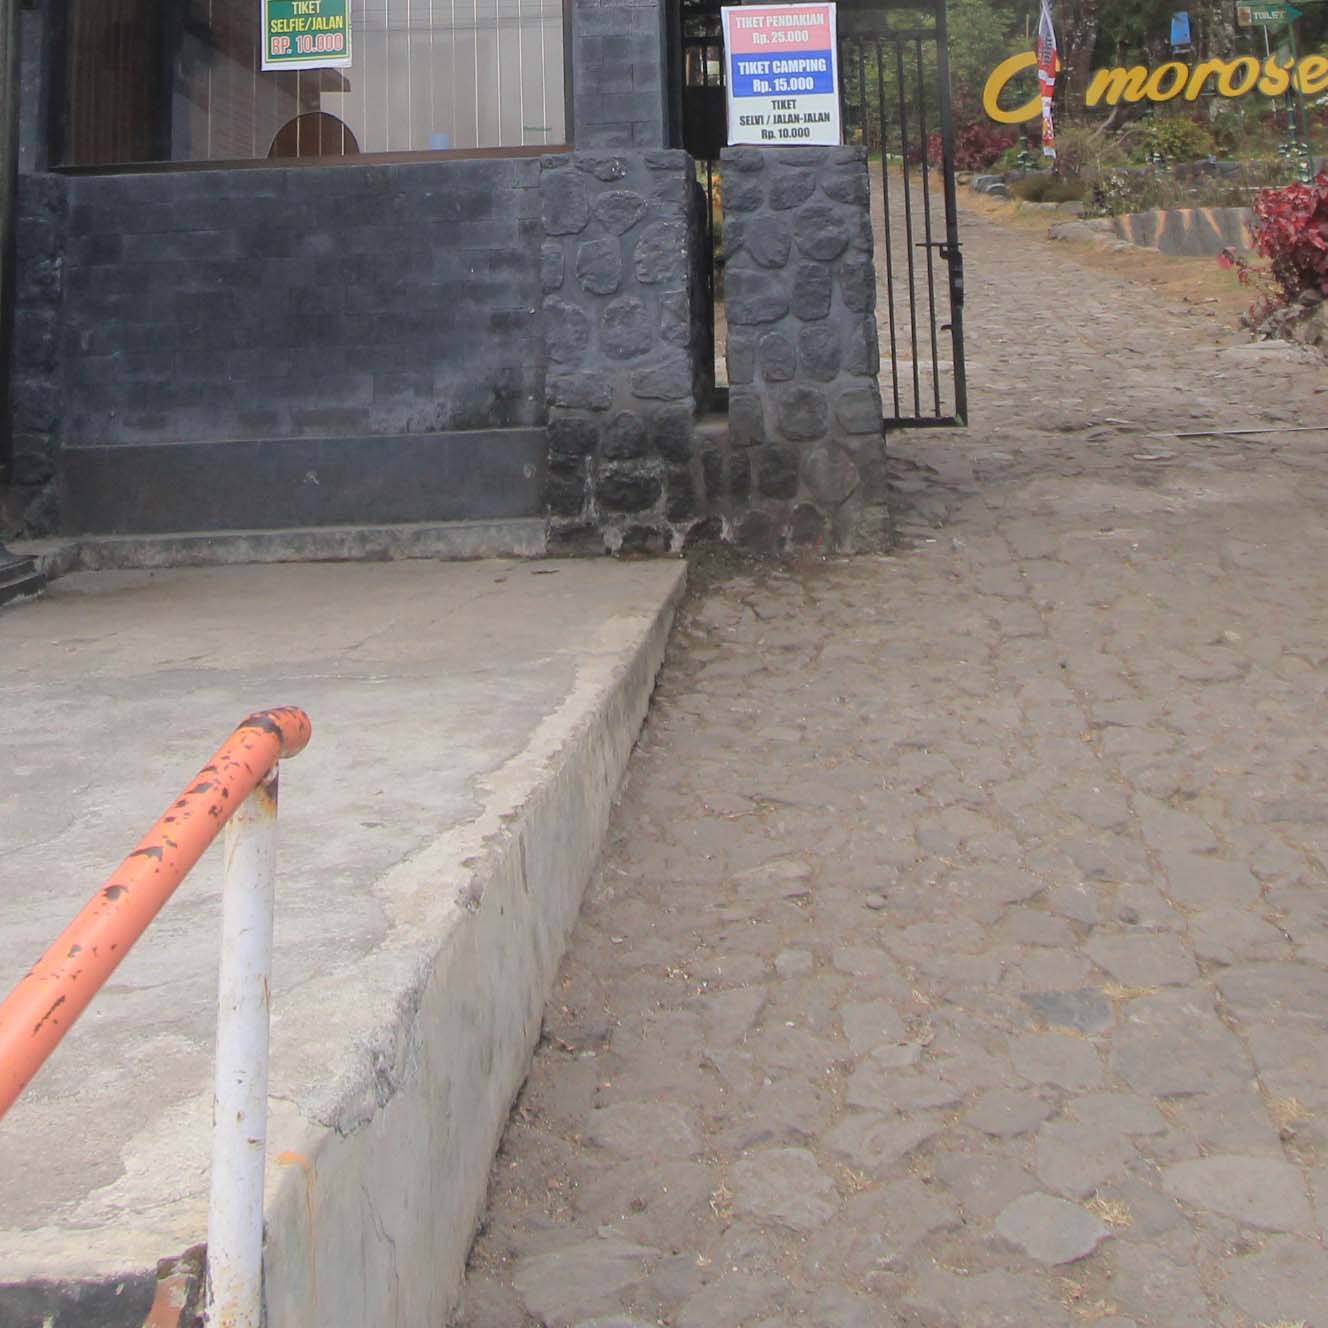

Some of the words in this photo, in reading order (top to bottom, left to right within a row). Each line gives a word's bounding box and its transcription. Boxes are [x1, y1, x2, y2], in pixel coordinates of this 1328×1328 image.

[291, 0, 322, 16] TIKET
[270, 15, 344, 33] SELFIE/JALAN
[736, 15, 765, 29] TIKET
[766, 13, 824, 27] PENDAKIAN
[270, 35, 293, 55] RP.
[295, 32, 344, 54] 10.000
[752, 32, 770, 45] Rp.
[771, 30, 809, 43] 25.000
[738, 61, 770, 75] TIKET
[772, 58, 827, 74] CAMPING
[752, 79, 772, 93] Rp.
[773, 76, 814, 91] 15.000
[771, 99, 797, 111] TIKET
[739, 115, 764, 126] SELVI
[773, 112, 830, 125] JALAN-JALAN
[761, 128, 777, 140] Rp.
[779, 127, 810, 139] 10.000
